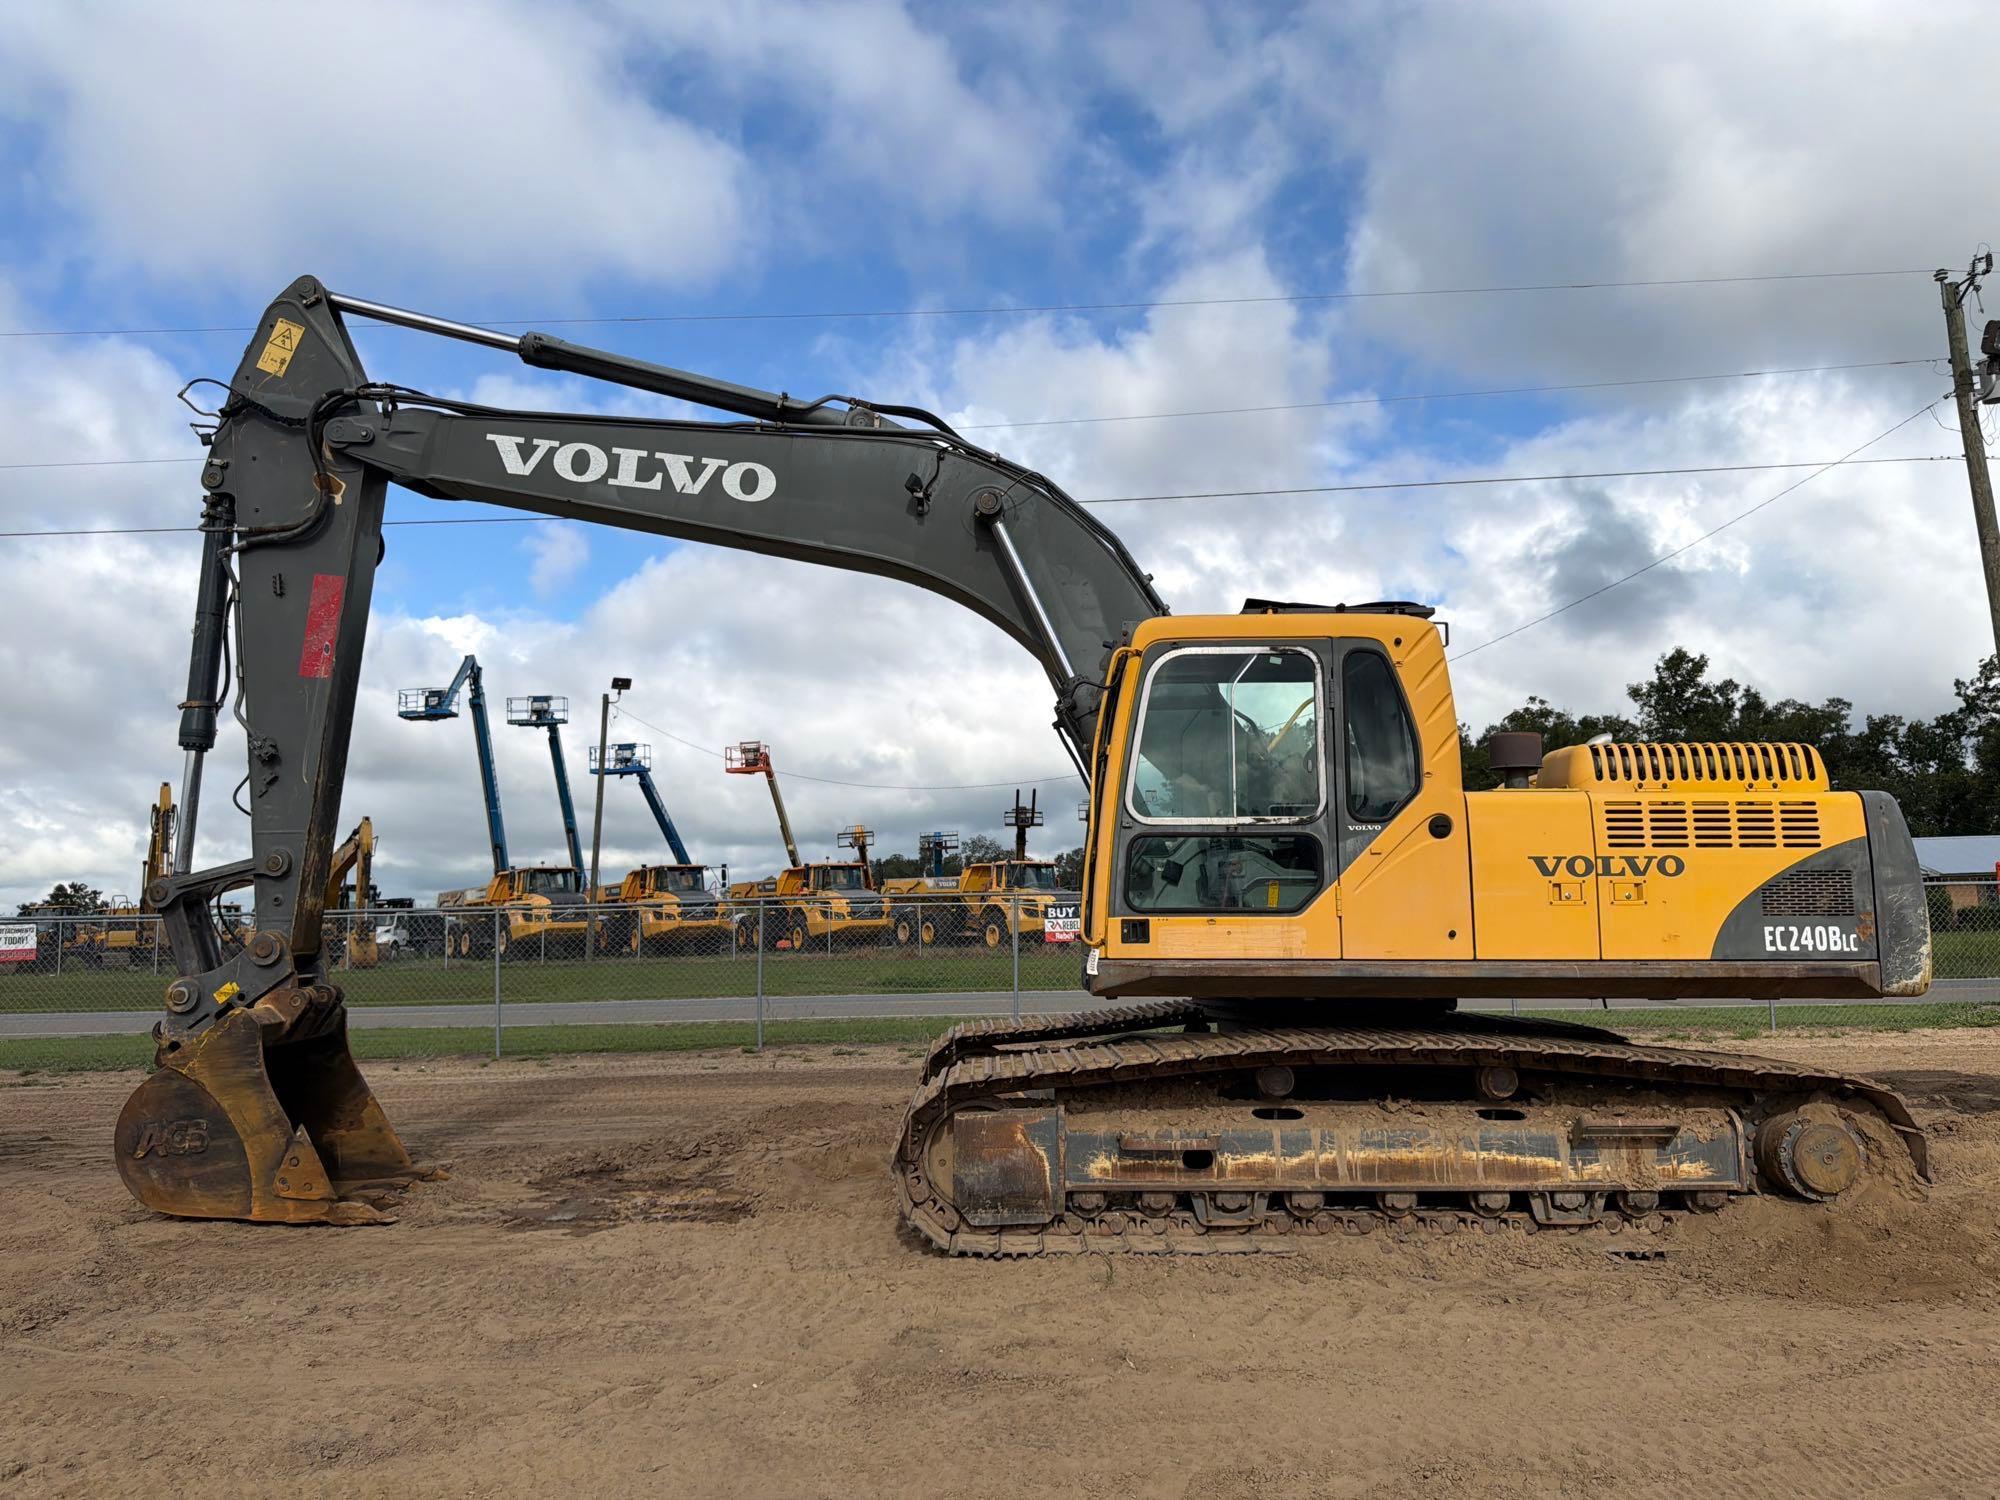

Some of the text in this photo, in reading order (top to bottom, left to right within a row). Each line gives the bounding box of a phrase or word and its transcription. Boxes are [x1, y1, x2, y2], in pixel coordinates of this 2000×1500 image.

[486, 433, 777, 502] VOLVO
[1527, 854, 1686, 878] VOLVO
[1047, 907, 1075, 918] BUY
[1062, 920, 1080, 930] REBEL
[4, 936, 28, 945] TODAY!
